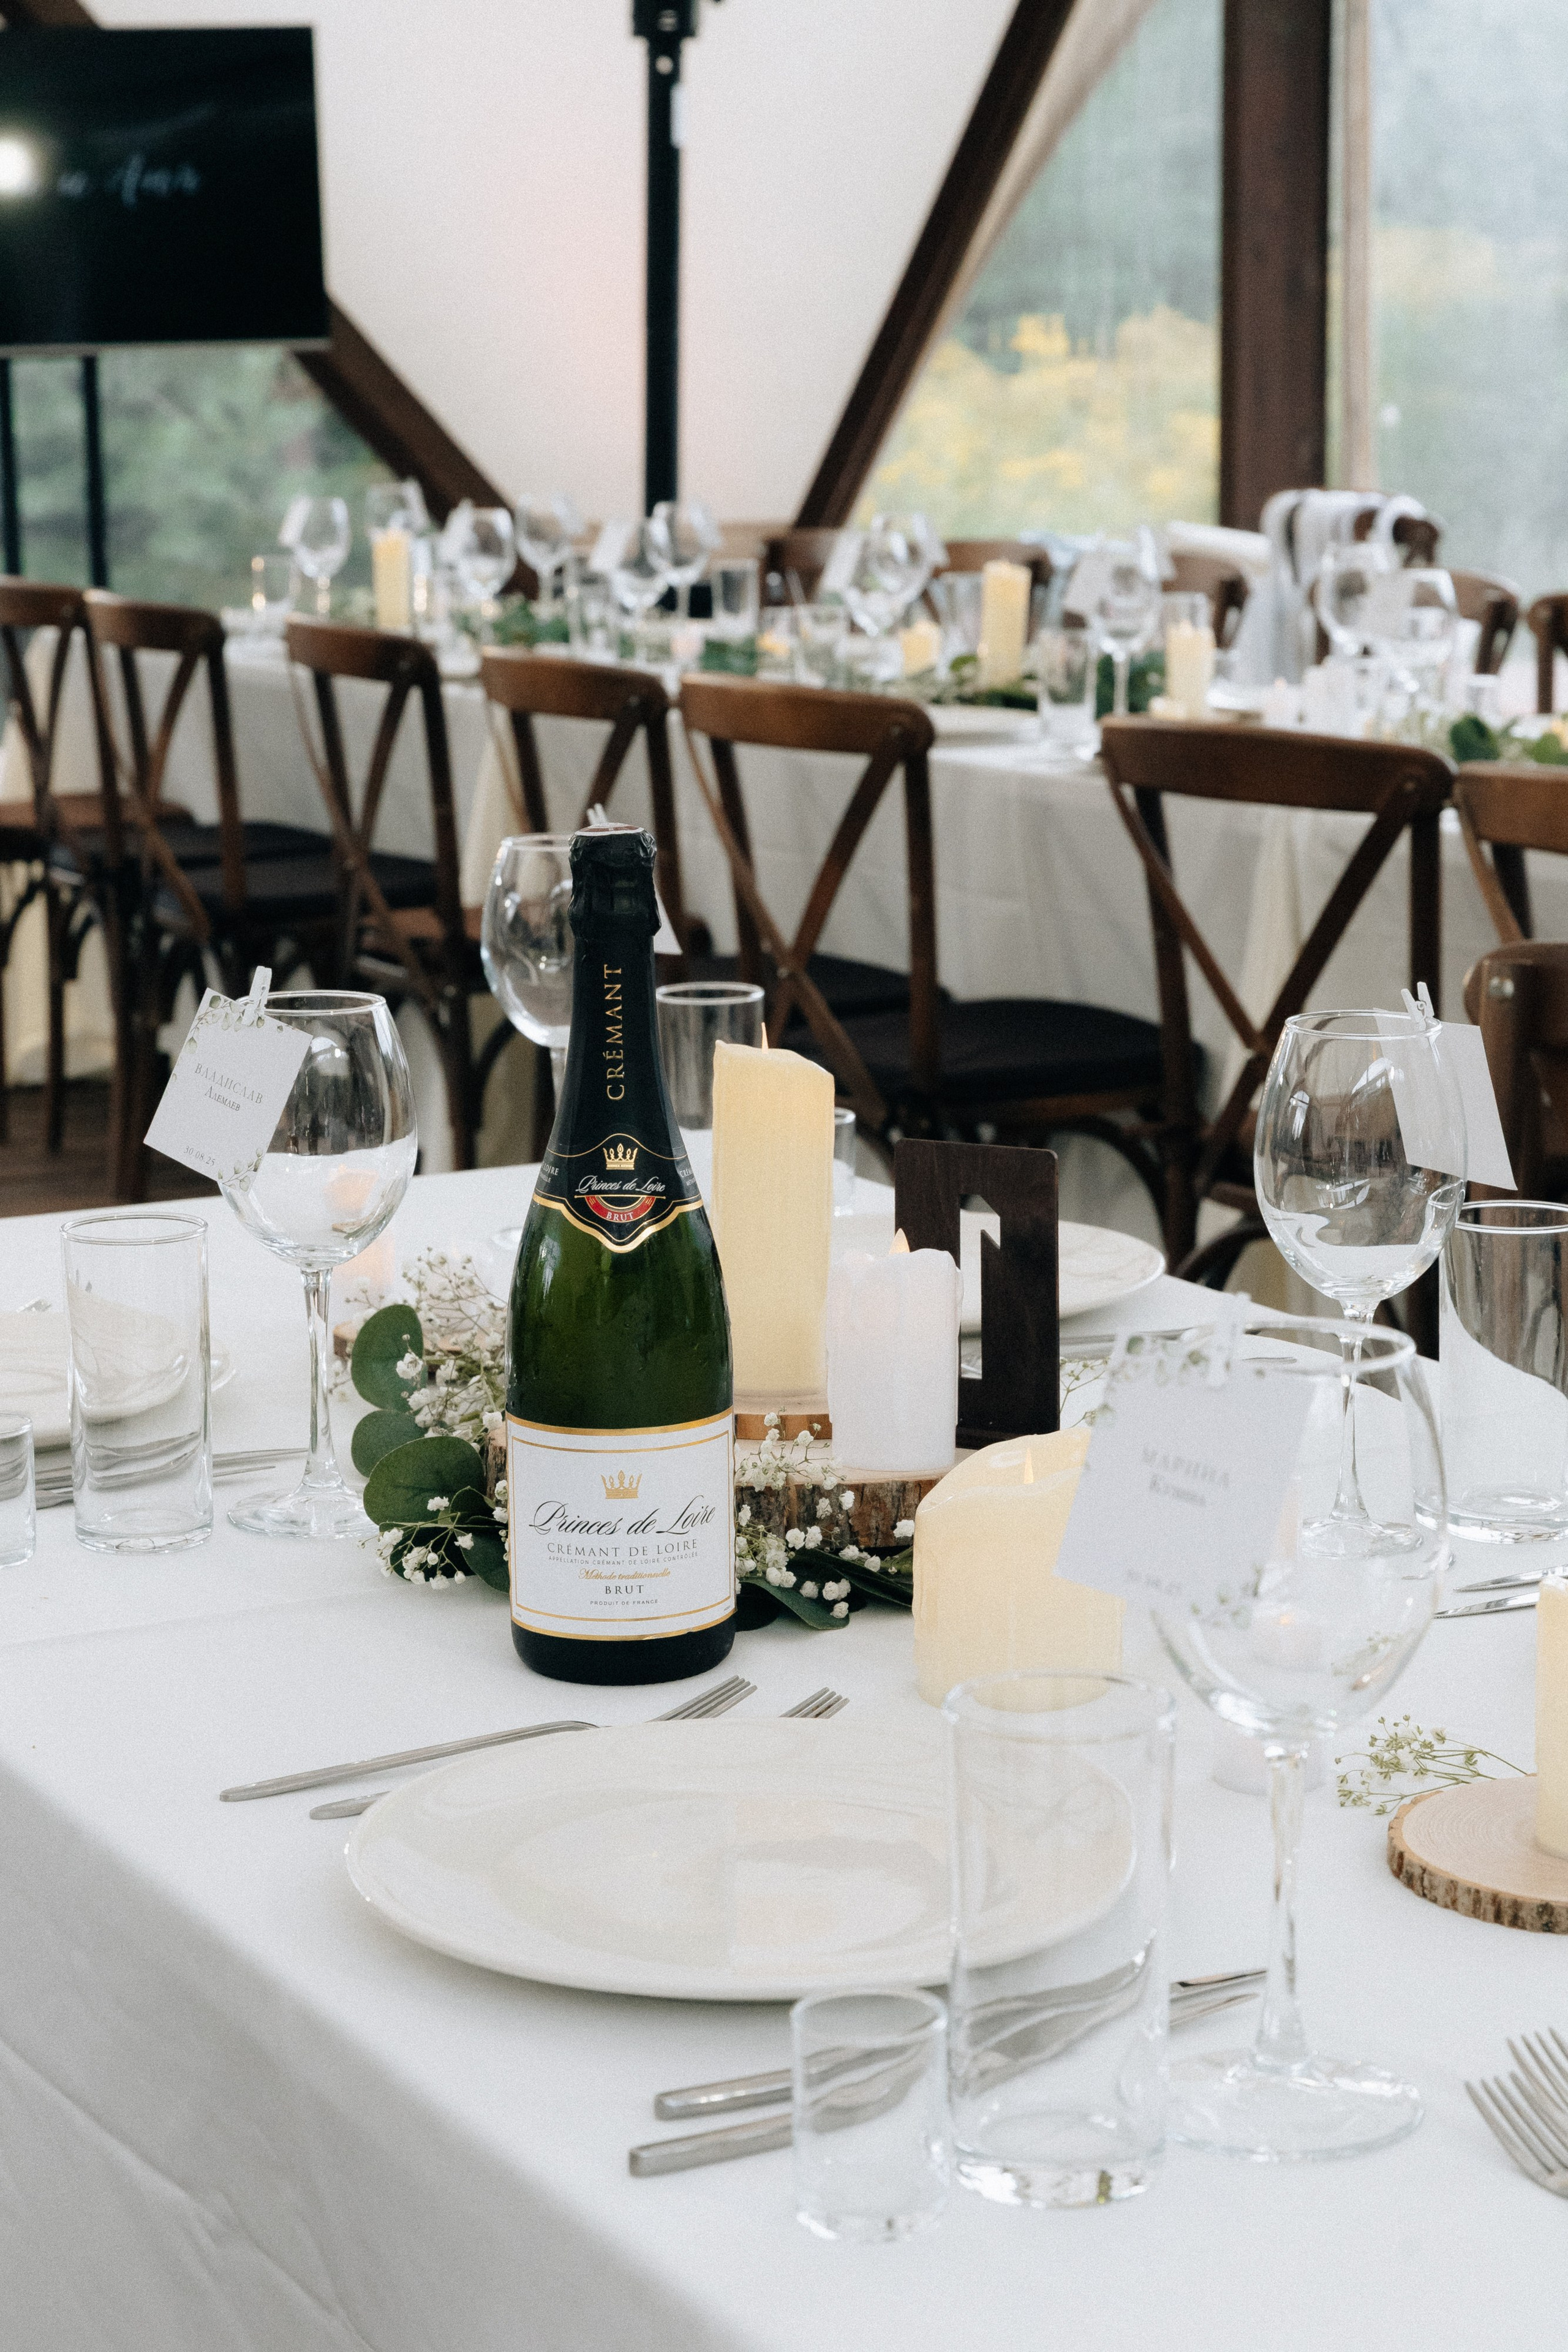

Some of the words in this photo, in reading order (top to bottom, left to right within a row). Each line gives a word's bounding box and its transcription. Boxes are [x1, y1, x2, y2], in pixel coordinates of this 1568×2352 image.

[603, 963, 625, 1101] CRÉMANT
[575, 1175, 622, 1194] Princes
[622, 1178, 638, 1190] de
[635, 1176, 666, 1194] Loire
[606, 1212, 634, 1221] BRUT
[529, 1500, 624, 1536] Princes
[627, 1508, 661, 1535] de
[655, 1494, 716, 1535] Loire
[547, 1542, 620, 1557] CRÉMANT
[629, 1546, 648, 1557] DE
[657, 1539, 698, 1555] LOIRE
[548, 1556, 589, 1565] APPELLATION
[663, 1551, 698, 1562] CONTRÔLÉE
[617, 1567, 671, 1580] traditionnelle
[605, 1585, 644, 1594] BRUT
